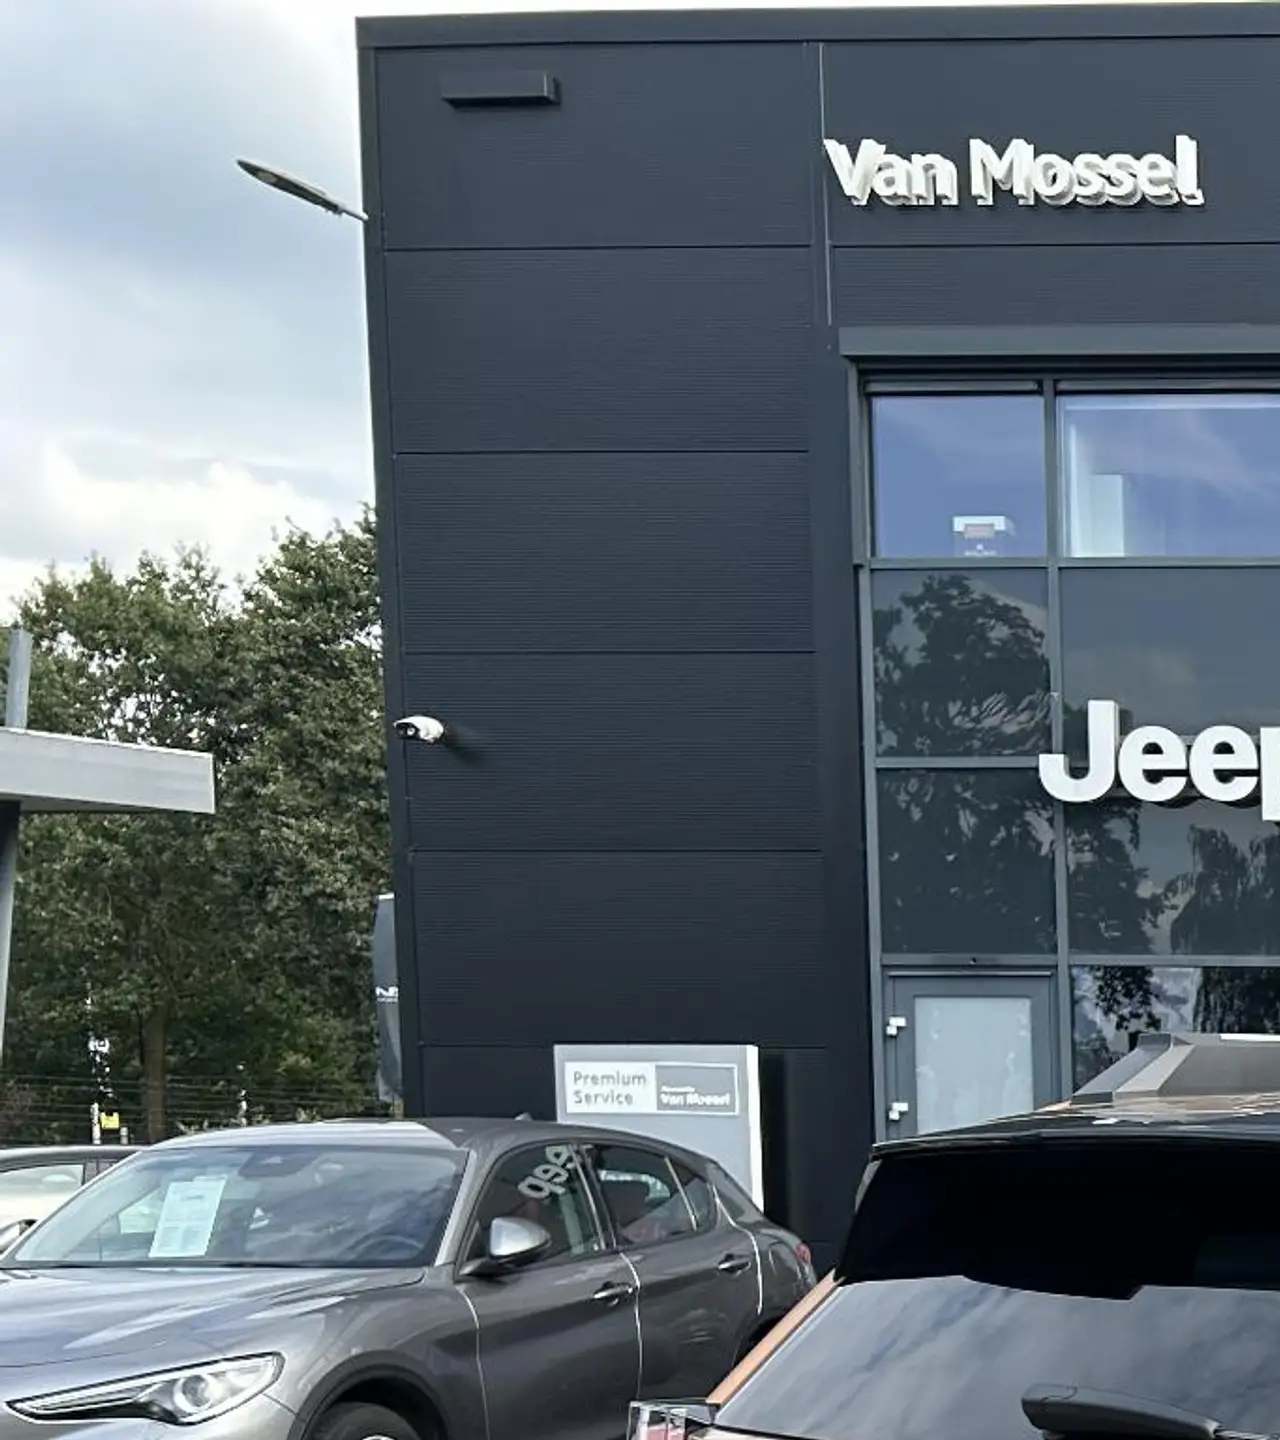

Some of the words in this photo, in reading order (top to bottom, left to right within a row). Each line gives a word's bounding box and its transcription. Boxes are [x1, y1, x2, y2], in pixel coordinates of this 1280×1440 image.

[823, 138, 959, 205] Van
[969, 134, 1205, 205] Mossel
[573, 1070, 647, 1087] Premium
[573, 1090, 633, 1105] Service
